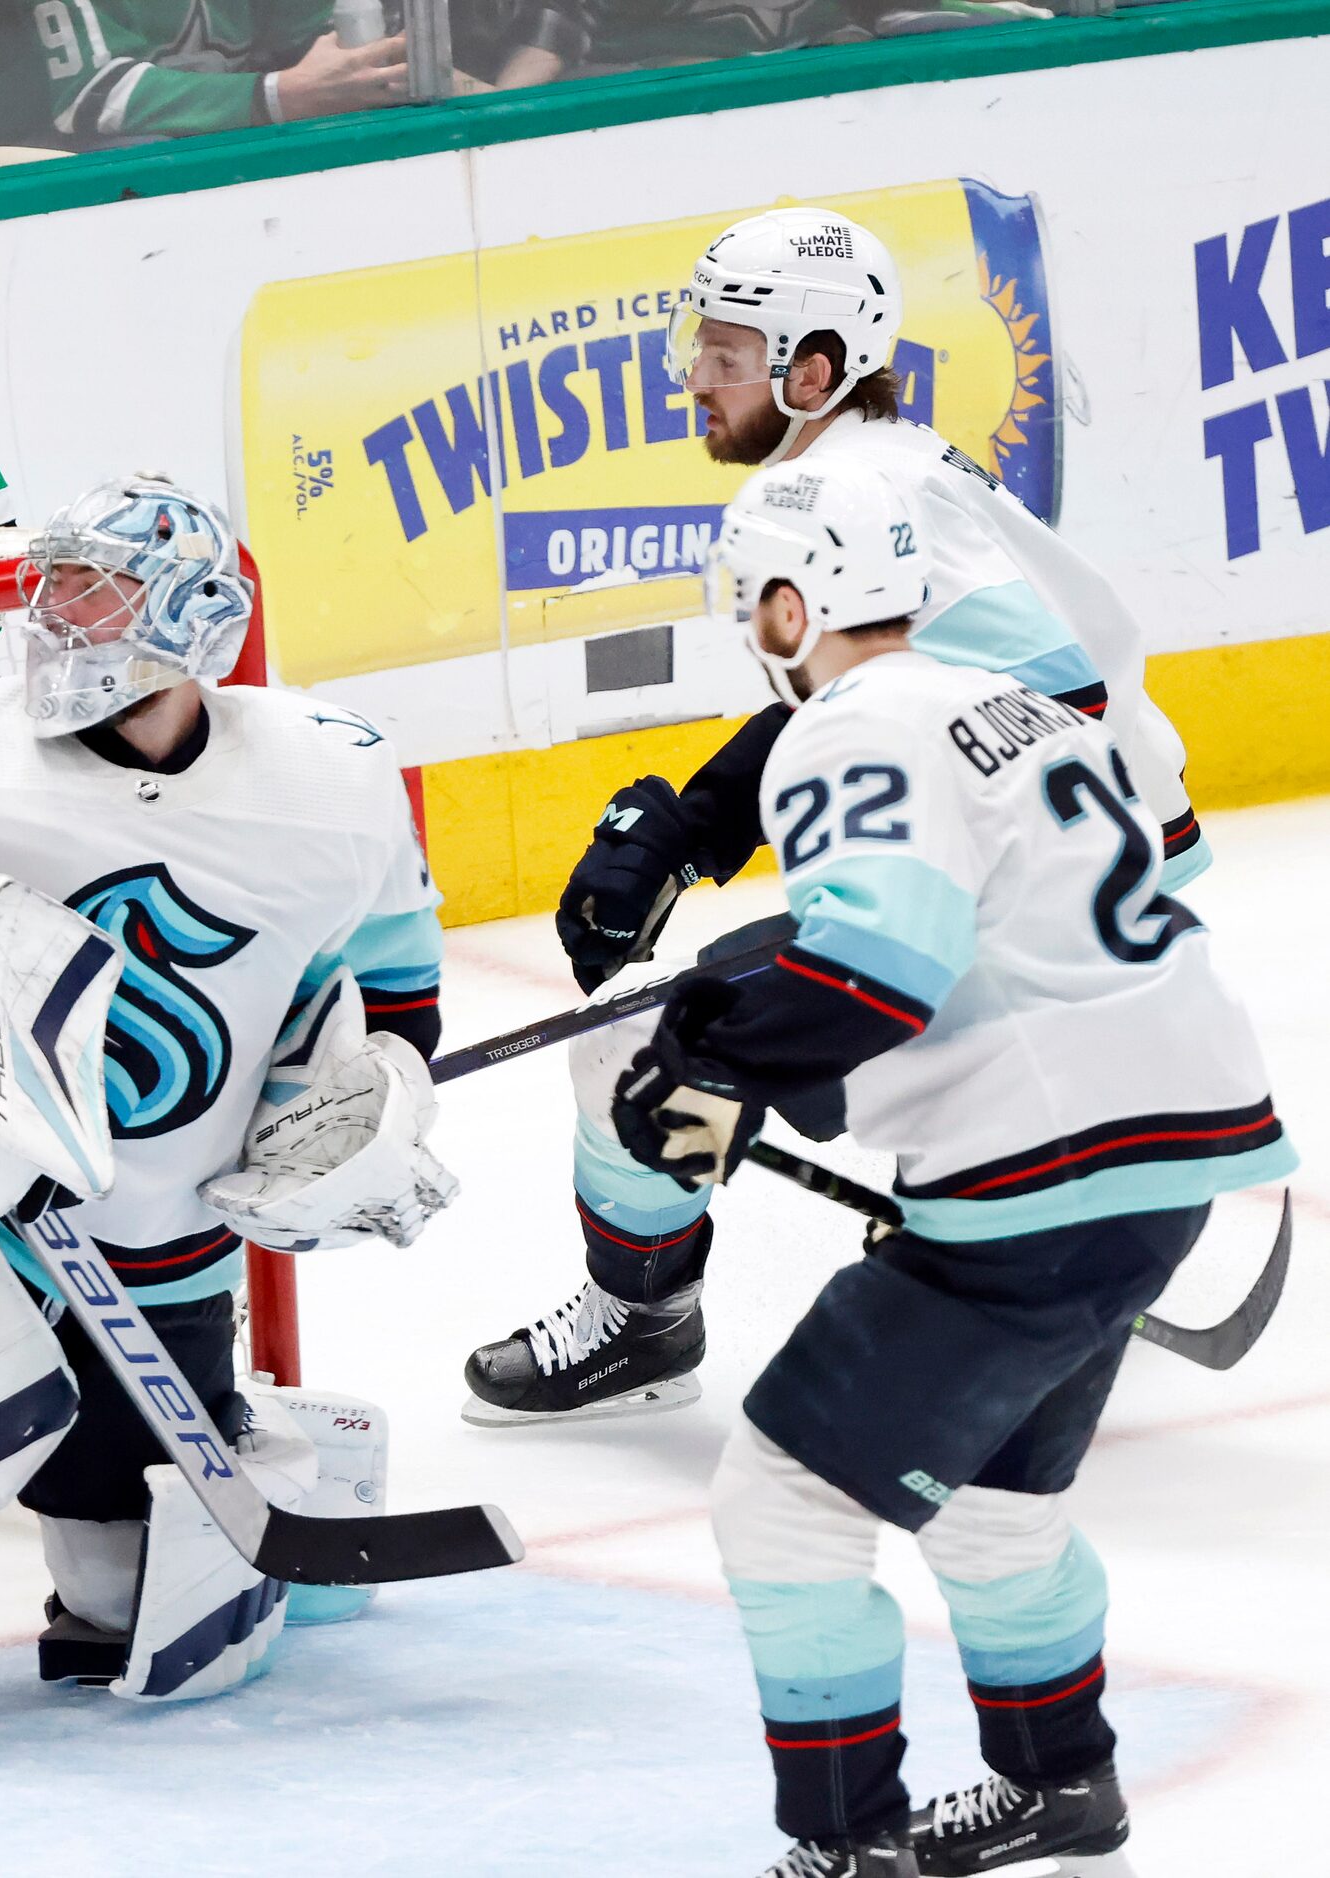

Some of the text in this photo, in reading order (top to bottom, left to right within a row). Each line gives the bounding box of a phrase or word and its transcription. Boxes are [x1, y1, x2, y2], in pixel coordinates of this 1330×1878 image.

[33, 0, 112, 80] 91
[790, 234, 852, 248] CLIMATE
[821, 225, 851, 237] THE
[798, 246, 854, 259] PLEDGE
[499, 303, 598, 351] HARD
[307, 449, 335, 498] 5%
[889, 521, 917, 559] 22
[774, 764, 912, 874] 22
[486, 1034, 542, 1061] TRIGGER
[255, 1096, 334, 1144] TRUE
[33, 1205, 234, 1481] BAUER
[578, 1357, 629, 1390] BAUER
[289, 1402, 367, 1417] CATALYST
[333, 1418, 371, 1431] PX3
